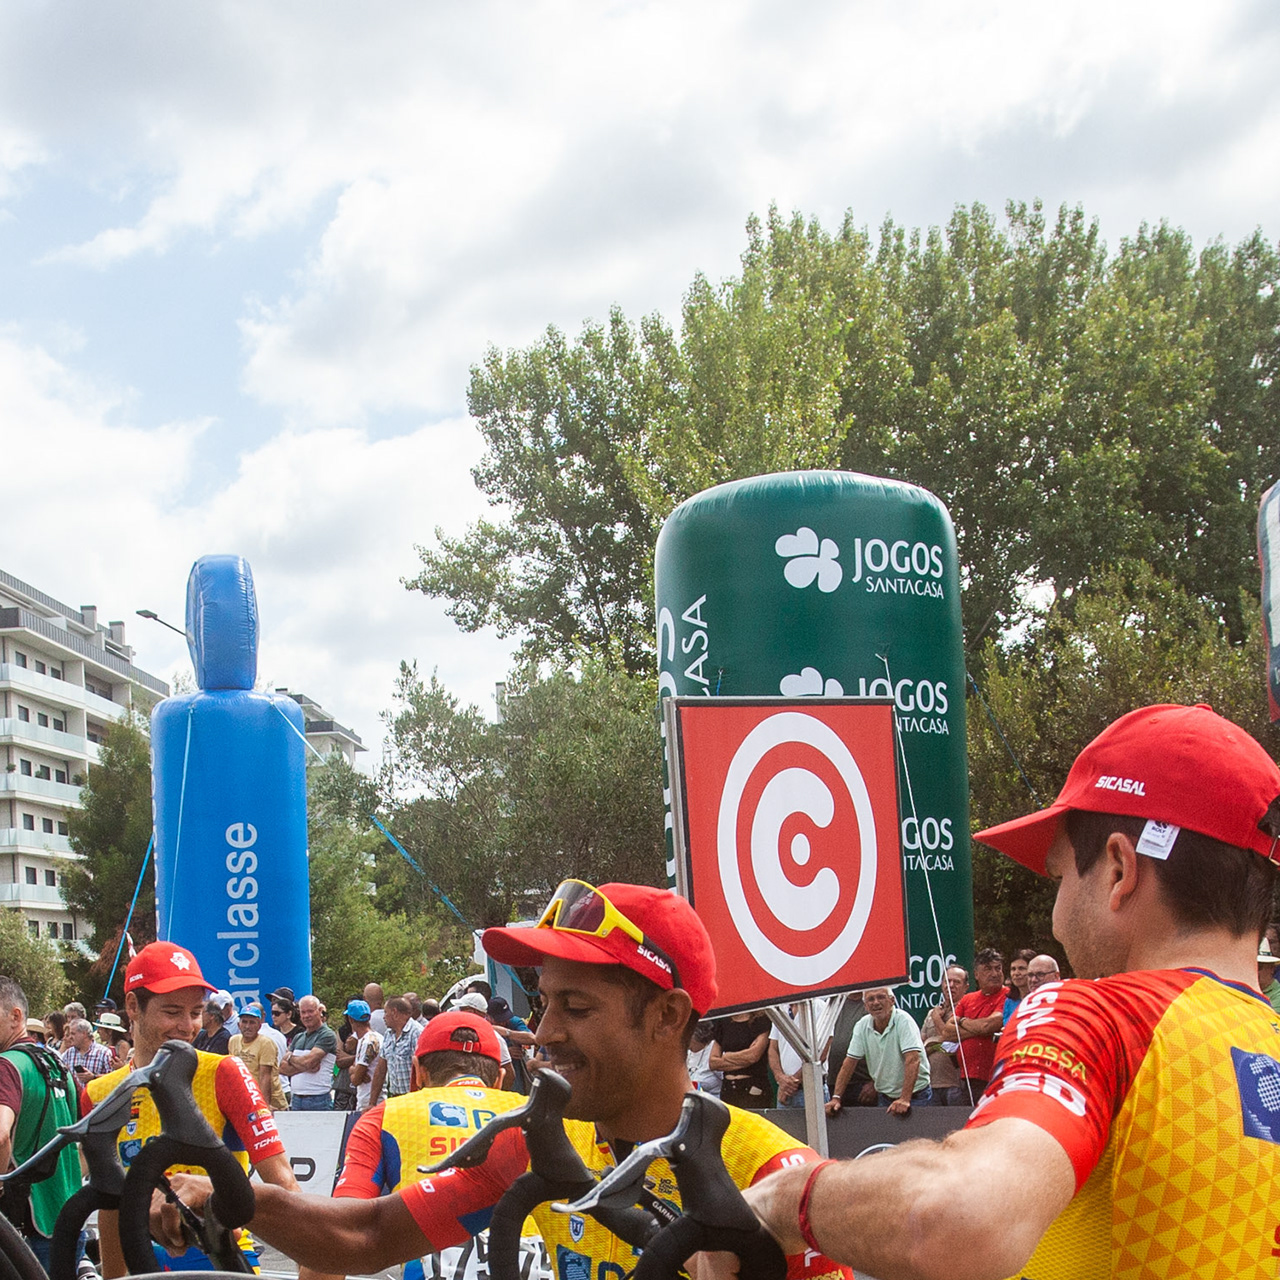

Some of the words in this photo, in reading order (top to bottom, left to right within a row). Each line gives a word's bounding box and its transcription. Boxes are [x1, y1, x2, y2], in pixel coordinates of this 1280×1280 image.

[853, 538, 944, 583] JOGOS
[866, 576, 945, 600] SANTACASA
[1095, 775, 1146, 797] SICASAL
[217, 822, 260, 1009] arclasse
[230, 1055, 264, 1106] SICASAL
[652, 1200, 676, 1222] GARMI
